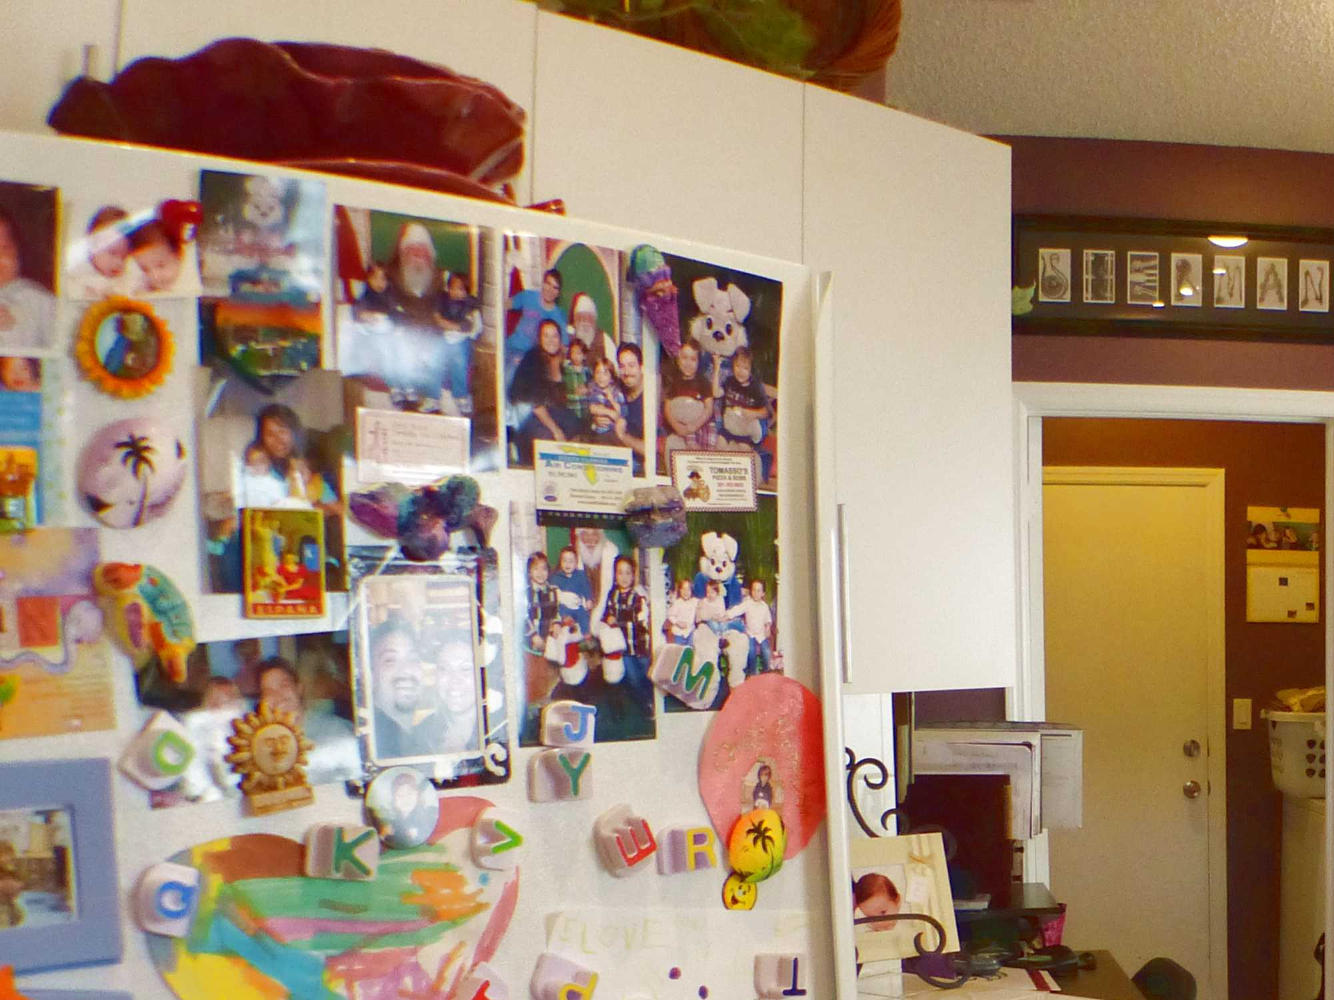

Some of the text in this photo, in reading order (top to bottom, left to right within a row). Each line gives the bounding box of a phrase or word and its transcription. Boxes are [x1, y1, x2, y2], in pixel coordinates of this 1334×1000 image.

[672, 646, 714, 692] M
[563, 705, 597, 741] J
[557, 752, 591, 795] Y
[334, 831, 373, 875] K
[617, 822, 657, 866] E
[687, 828, 716, 870] R
